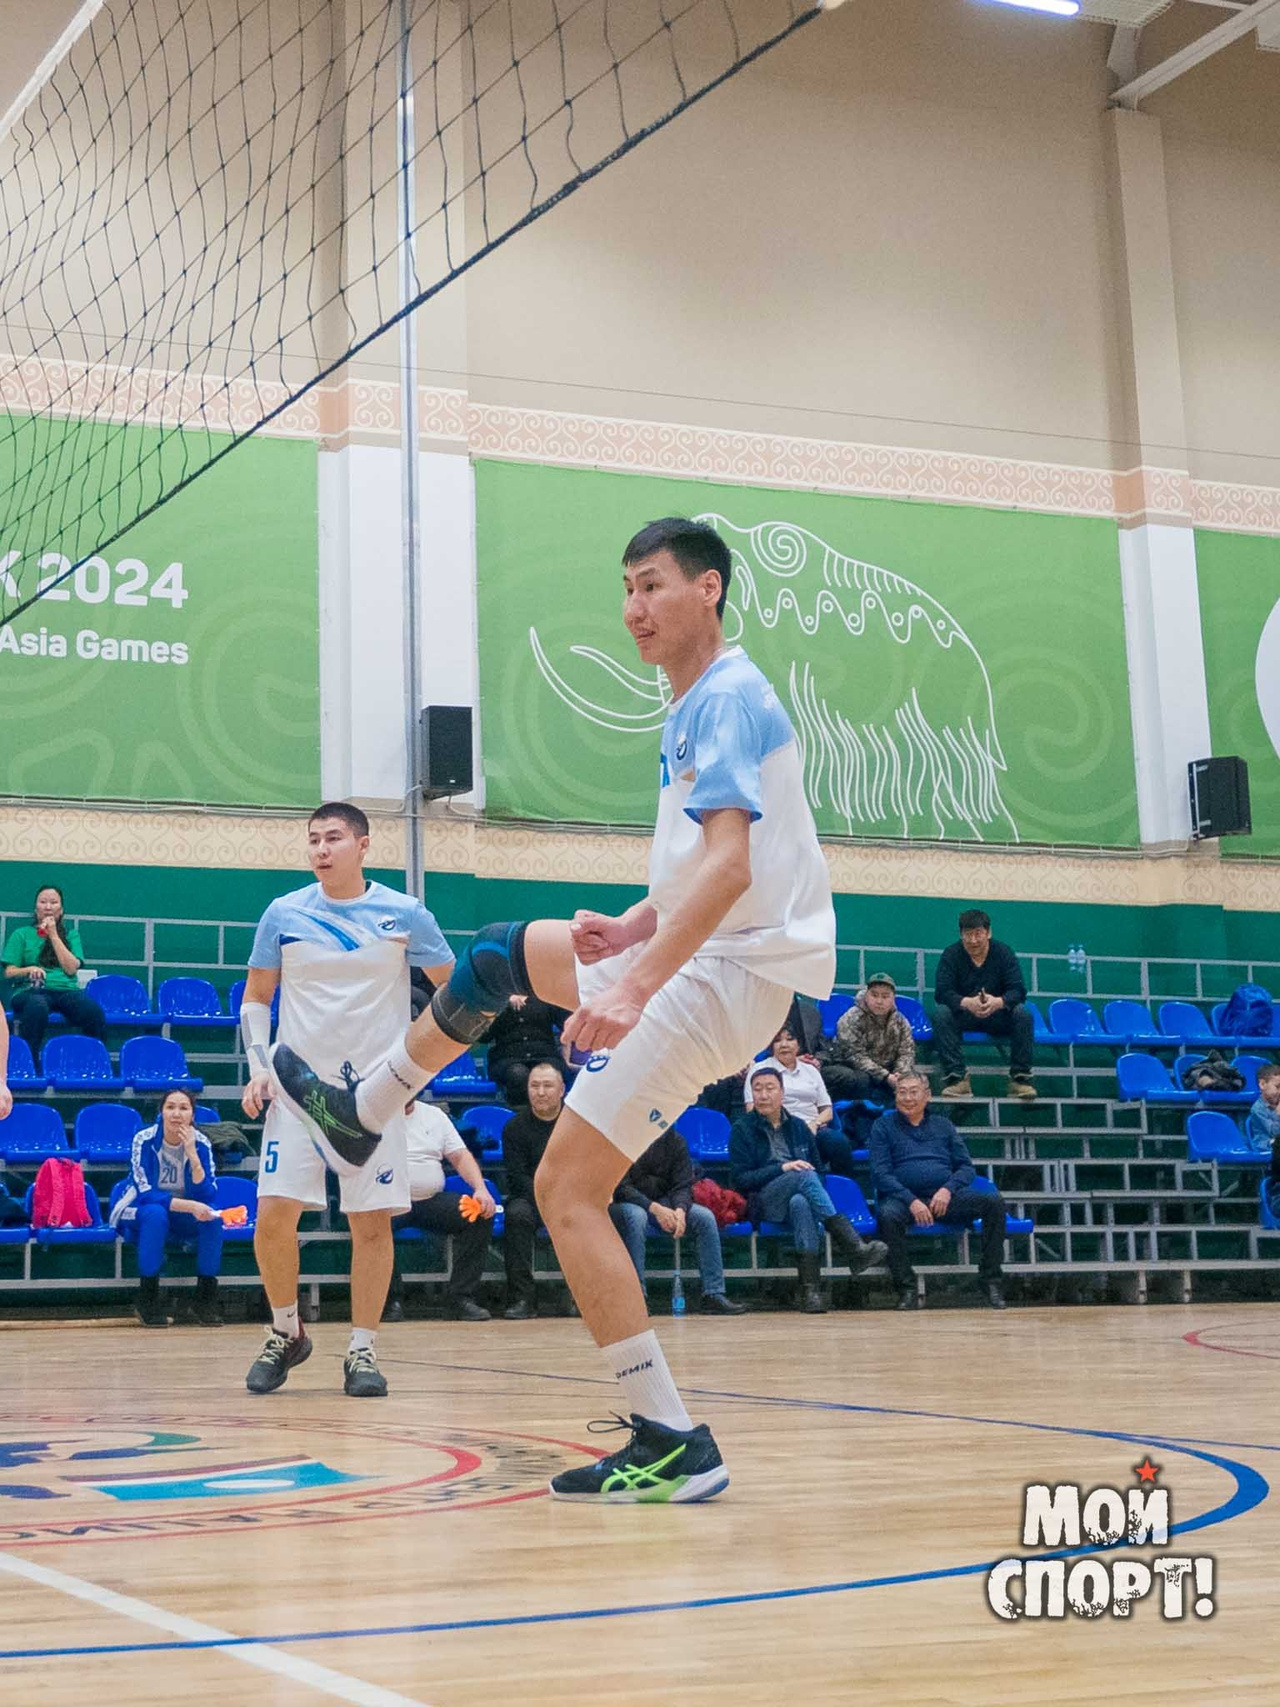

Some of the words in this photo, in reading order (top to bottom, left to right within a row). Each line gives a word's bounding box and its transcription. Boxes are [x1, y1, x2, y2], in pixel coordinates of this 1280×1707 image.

[36, 552, 188, 608] 2024
[76, 630, 189, 664] Games
[265, 1140, 279, 1174] 5
[160, 1166, 178, 1185] 20
